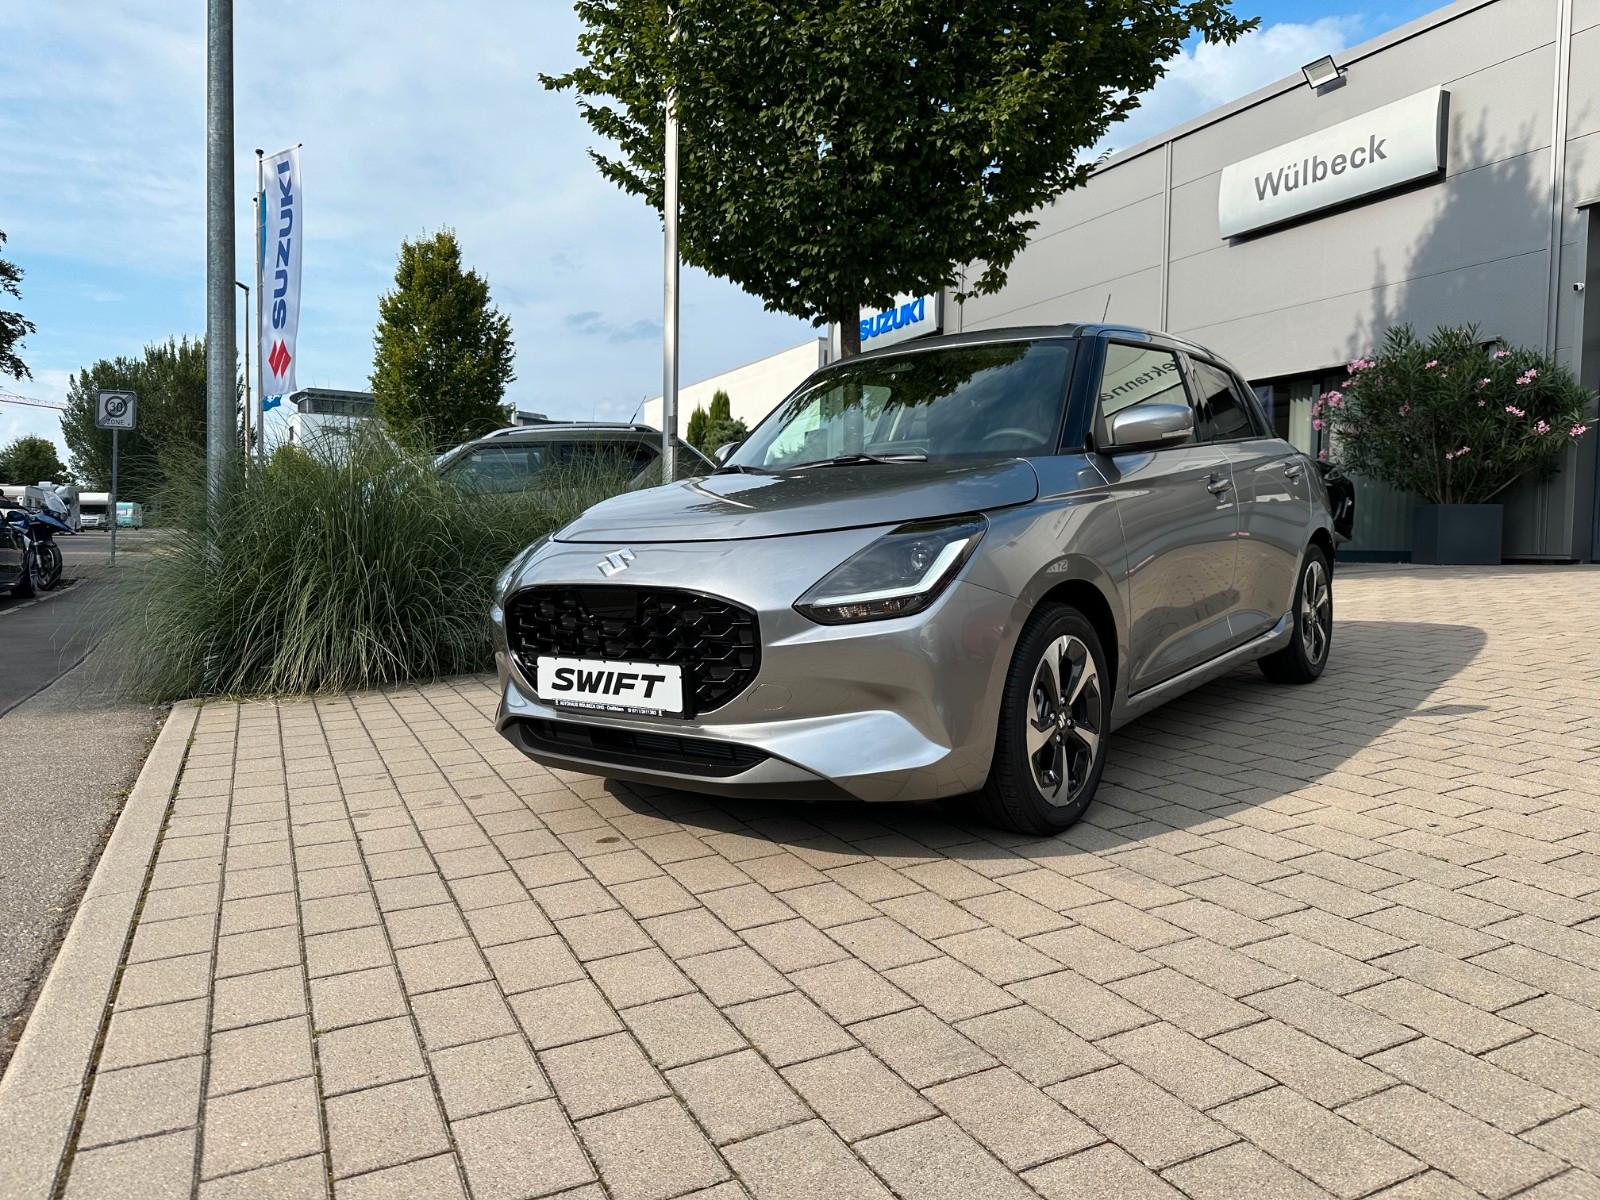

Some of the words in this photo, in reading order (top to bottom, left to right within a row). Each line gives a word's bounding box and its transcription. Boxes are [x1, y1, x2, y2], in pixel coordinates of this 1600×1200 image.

[1254, 134, 1387, 201] Wülbeck
[272, 160, 294, 329] SUZUKI
[859, 296, 925, 341] SUZUKI
[106, 418, 125, 426] ZONE
[109, 401, 123, 412] 30
[551, 667, 666, 699] SWIFT
